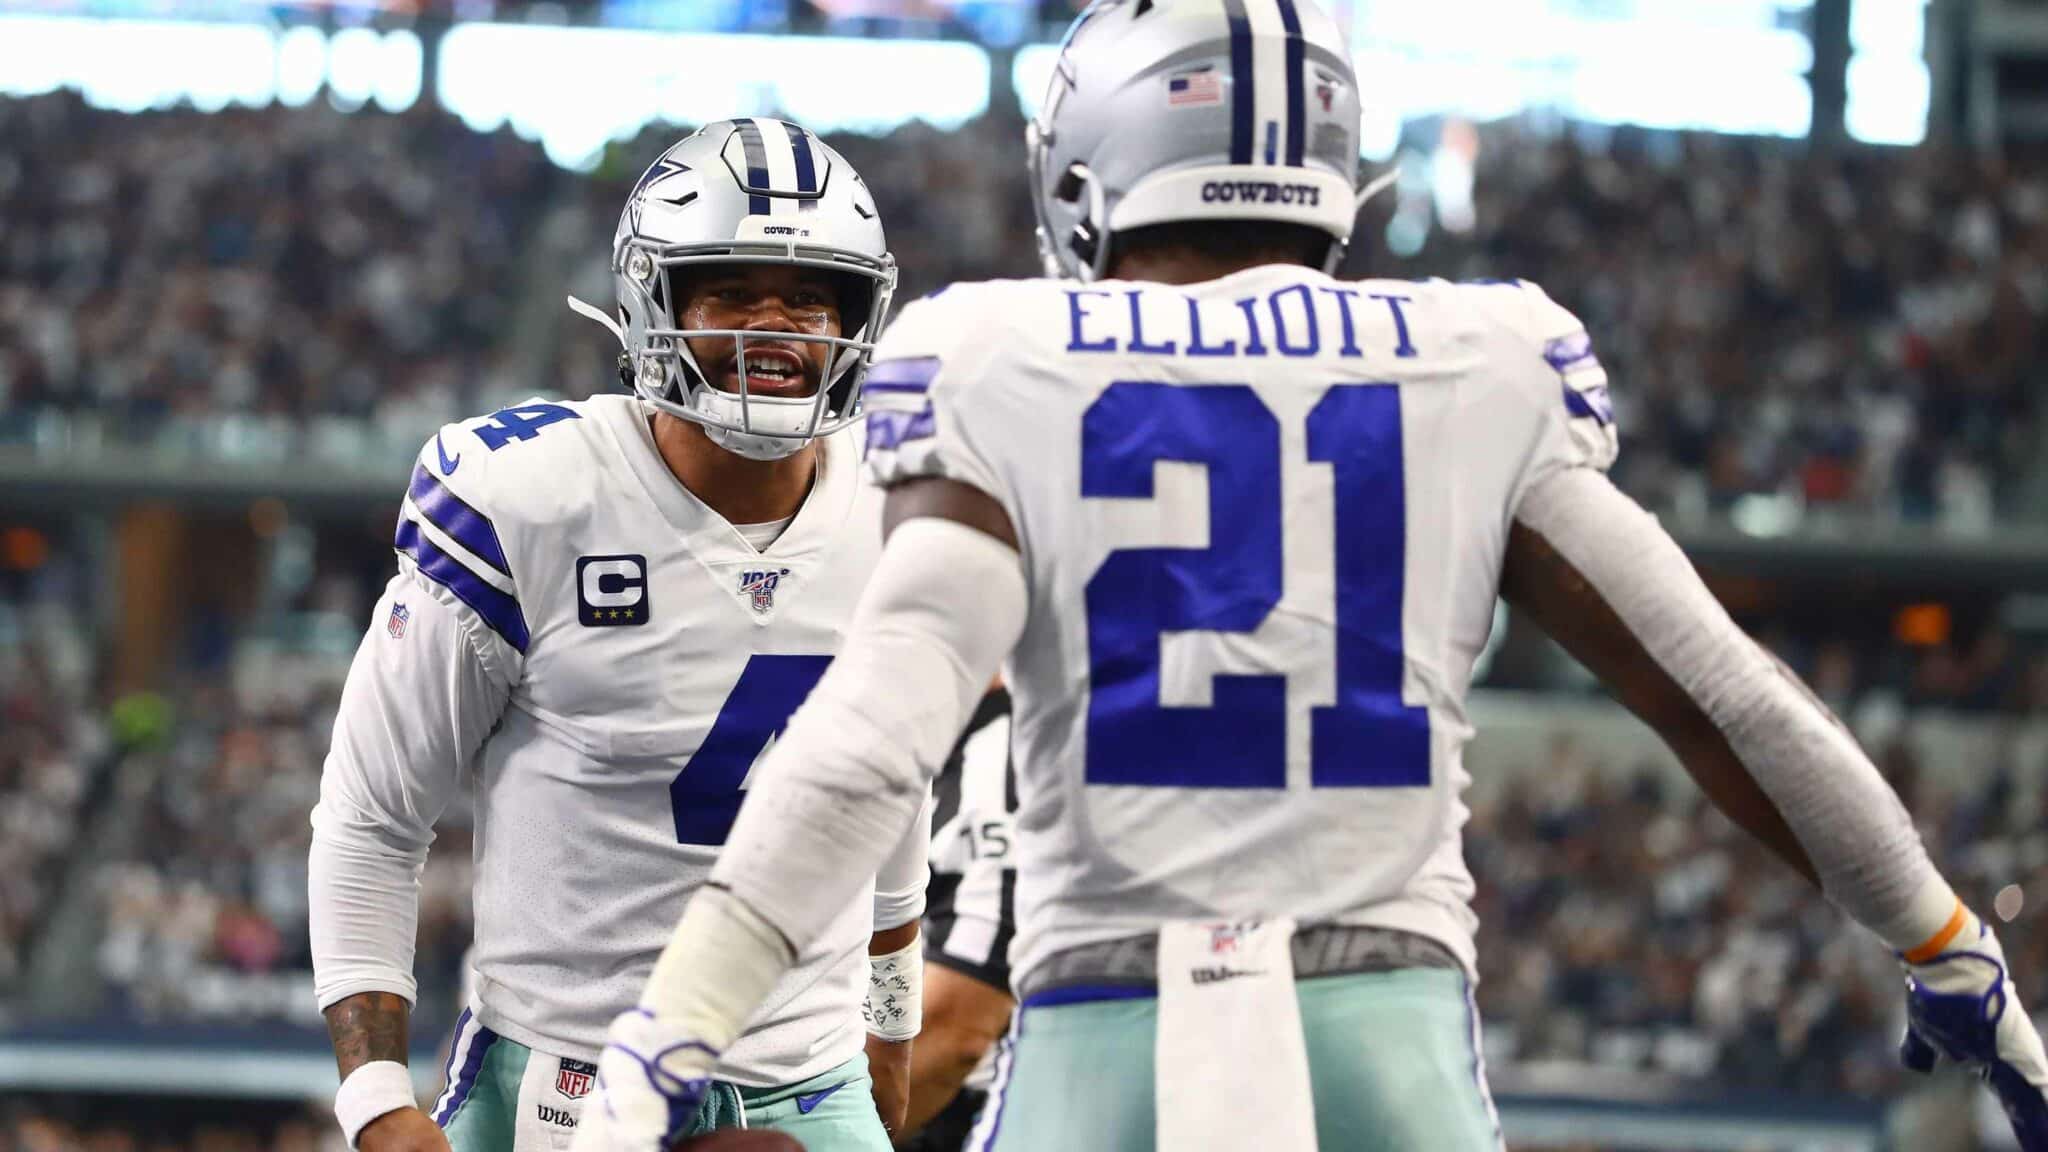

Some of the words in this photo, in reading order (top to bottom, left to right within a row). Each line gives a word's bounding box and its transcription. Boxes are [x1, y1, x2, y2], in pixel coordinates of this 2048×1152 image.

[1201, 181, 1321, 206] COWBOYS
[764, 225, 810, 237] COWBS
[1062, 283, 1419, 358] ELLIOTT
[472, 403, 584, 452] 4
[582, 559, 643, 608] C
[1080, 381, 1432, 790] 21
[958, 821, 1010, 862] 15
[558, 1070, 591, 1097] NFL
[537, 1103, 579, 1128] Wils
